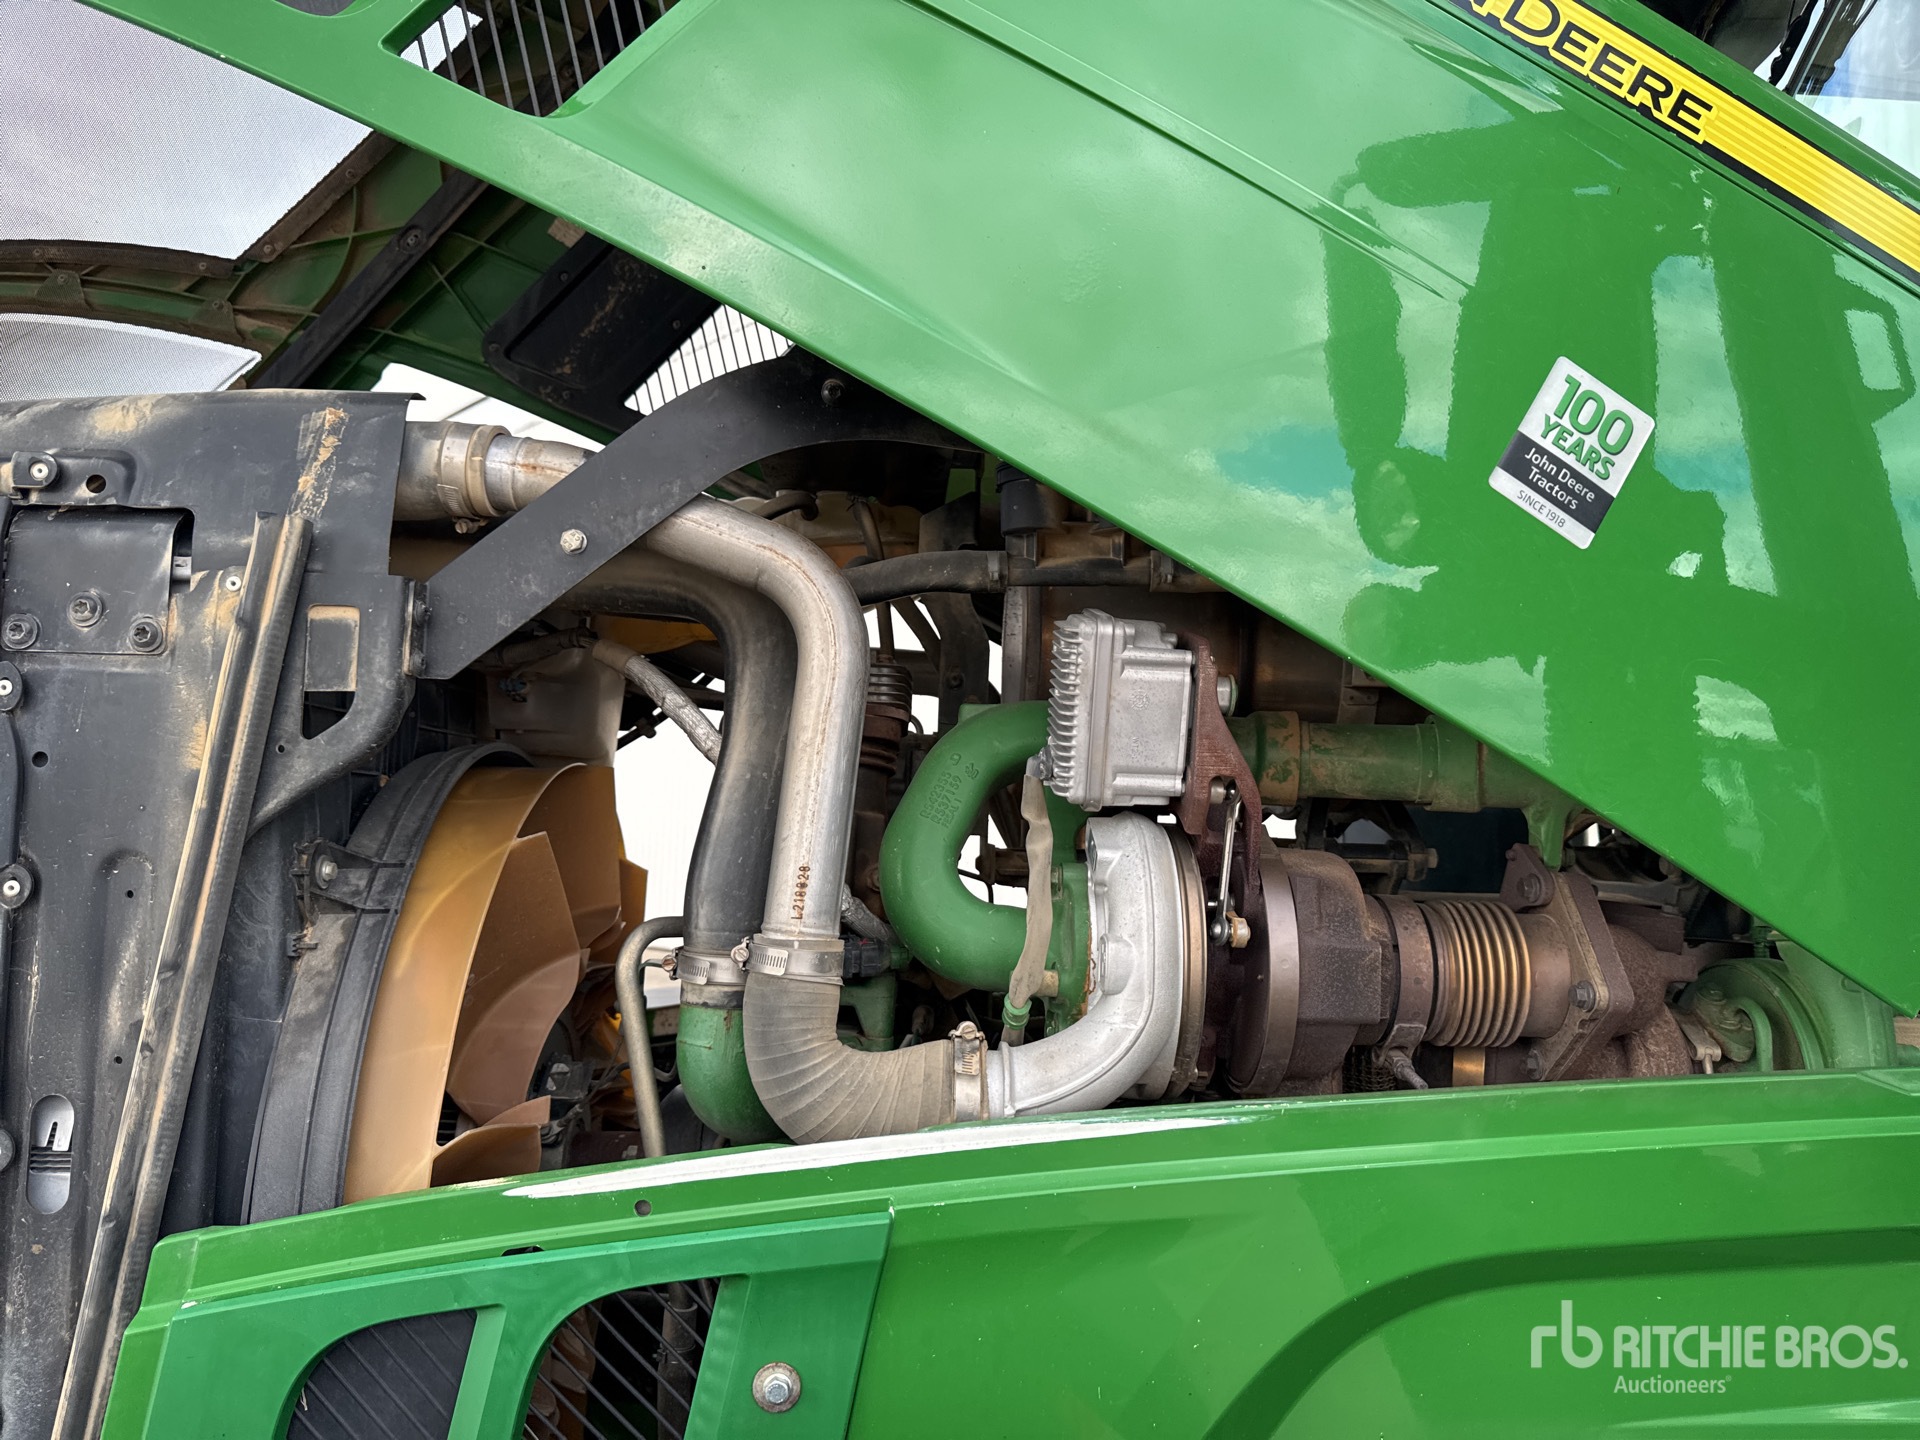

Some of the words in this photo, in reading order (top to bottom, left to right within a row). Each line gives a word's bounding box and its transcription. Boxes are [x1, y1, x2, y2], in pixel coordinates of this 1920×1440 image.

[1503, 0, 1712, 136] DEERE
[1554, 374, 1634, 456] 100
[1524, 448, 1557, 476] John
[1558, 468, 1595, 503] Deere
[1540, 414, 1616, 481] YEARS
[1517, 489, 1546, 515] SINCE
[1545, 508, 1566, 529] 1918
[1528, 466, 1579, 510] Tractors
